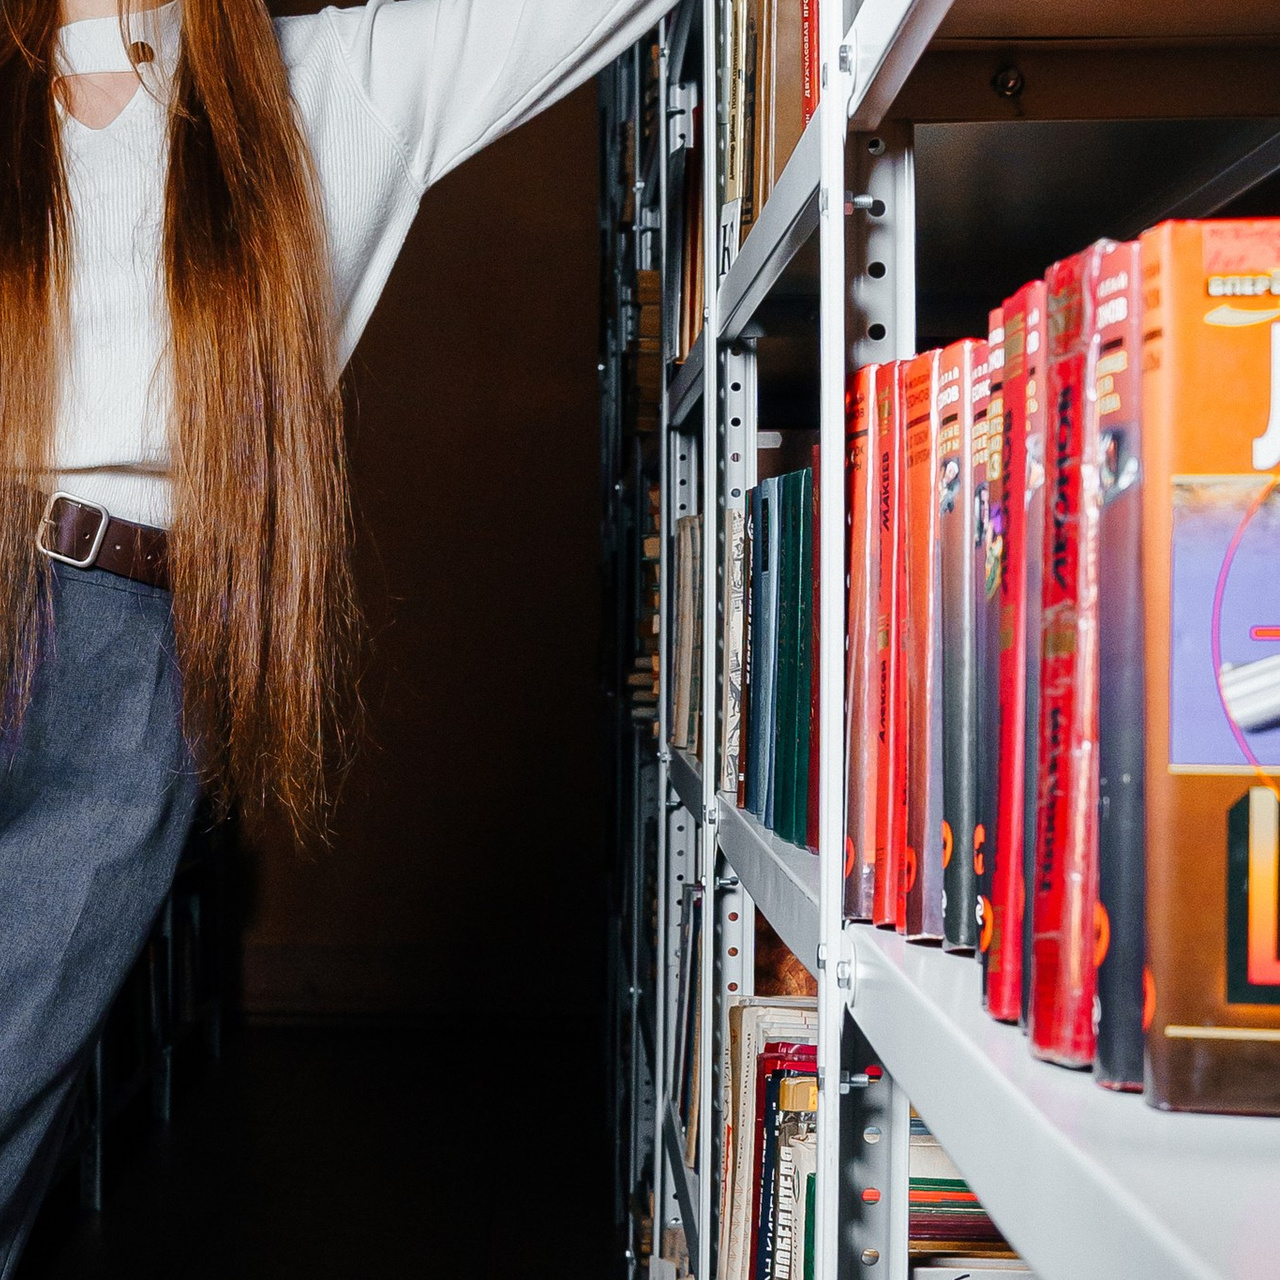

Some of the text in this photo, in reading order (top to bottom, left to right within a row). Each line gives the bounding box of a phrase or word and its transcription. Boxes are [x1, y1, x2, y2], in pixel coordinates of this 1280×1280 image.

[803, 21, 812, 98] ДВУХЧАСОВАЯ
[881, 451, 891, 531] МАКЕЕВ
[774, 1146, 793, 1280] ПОБЕДИТЕЛЯ
